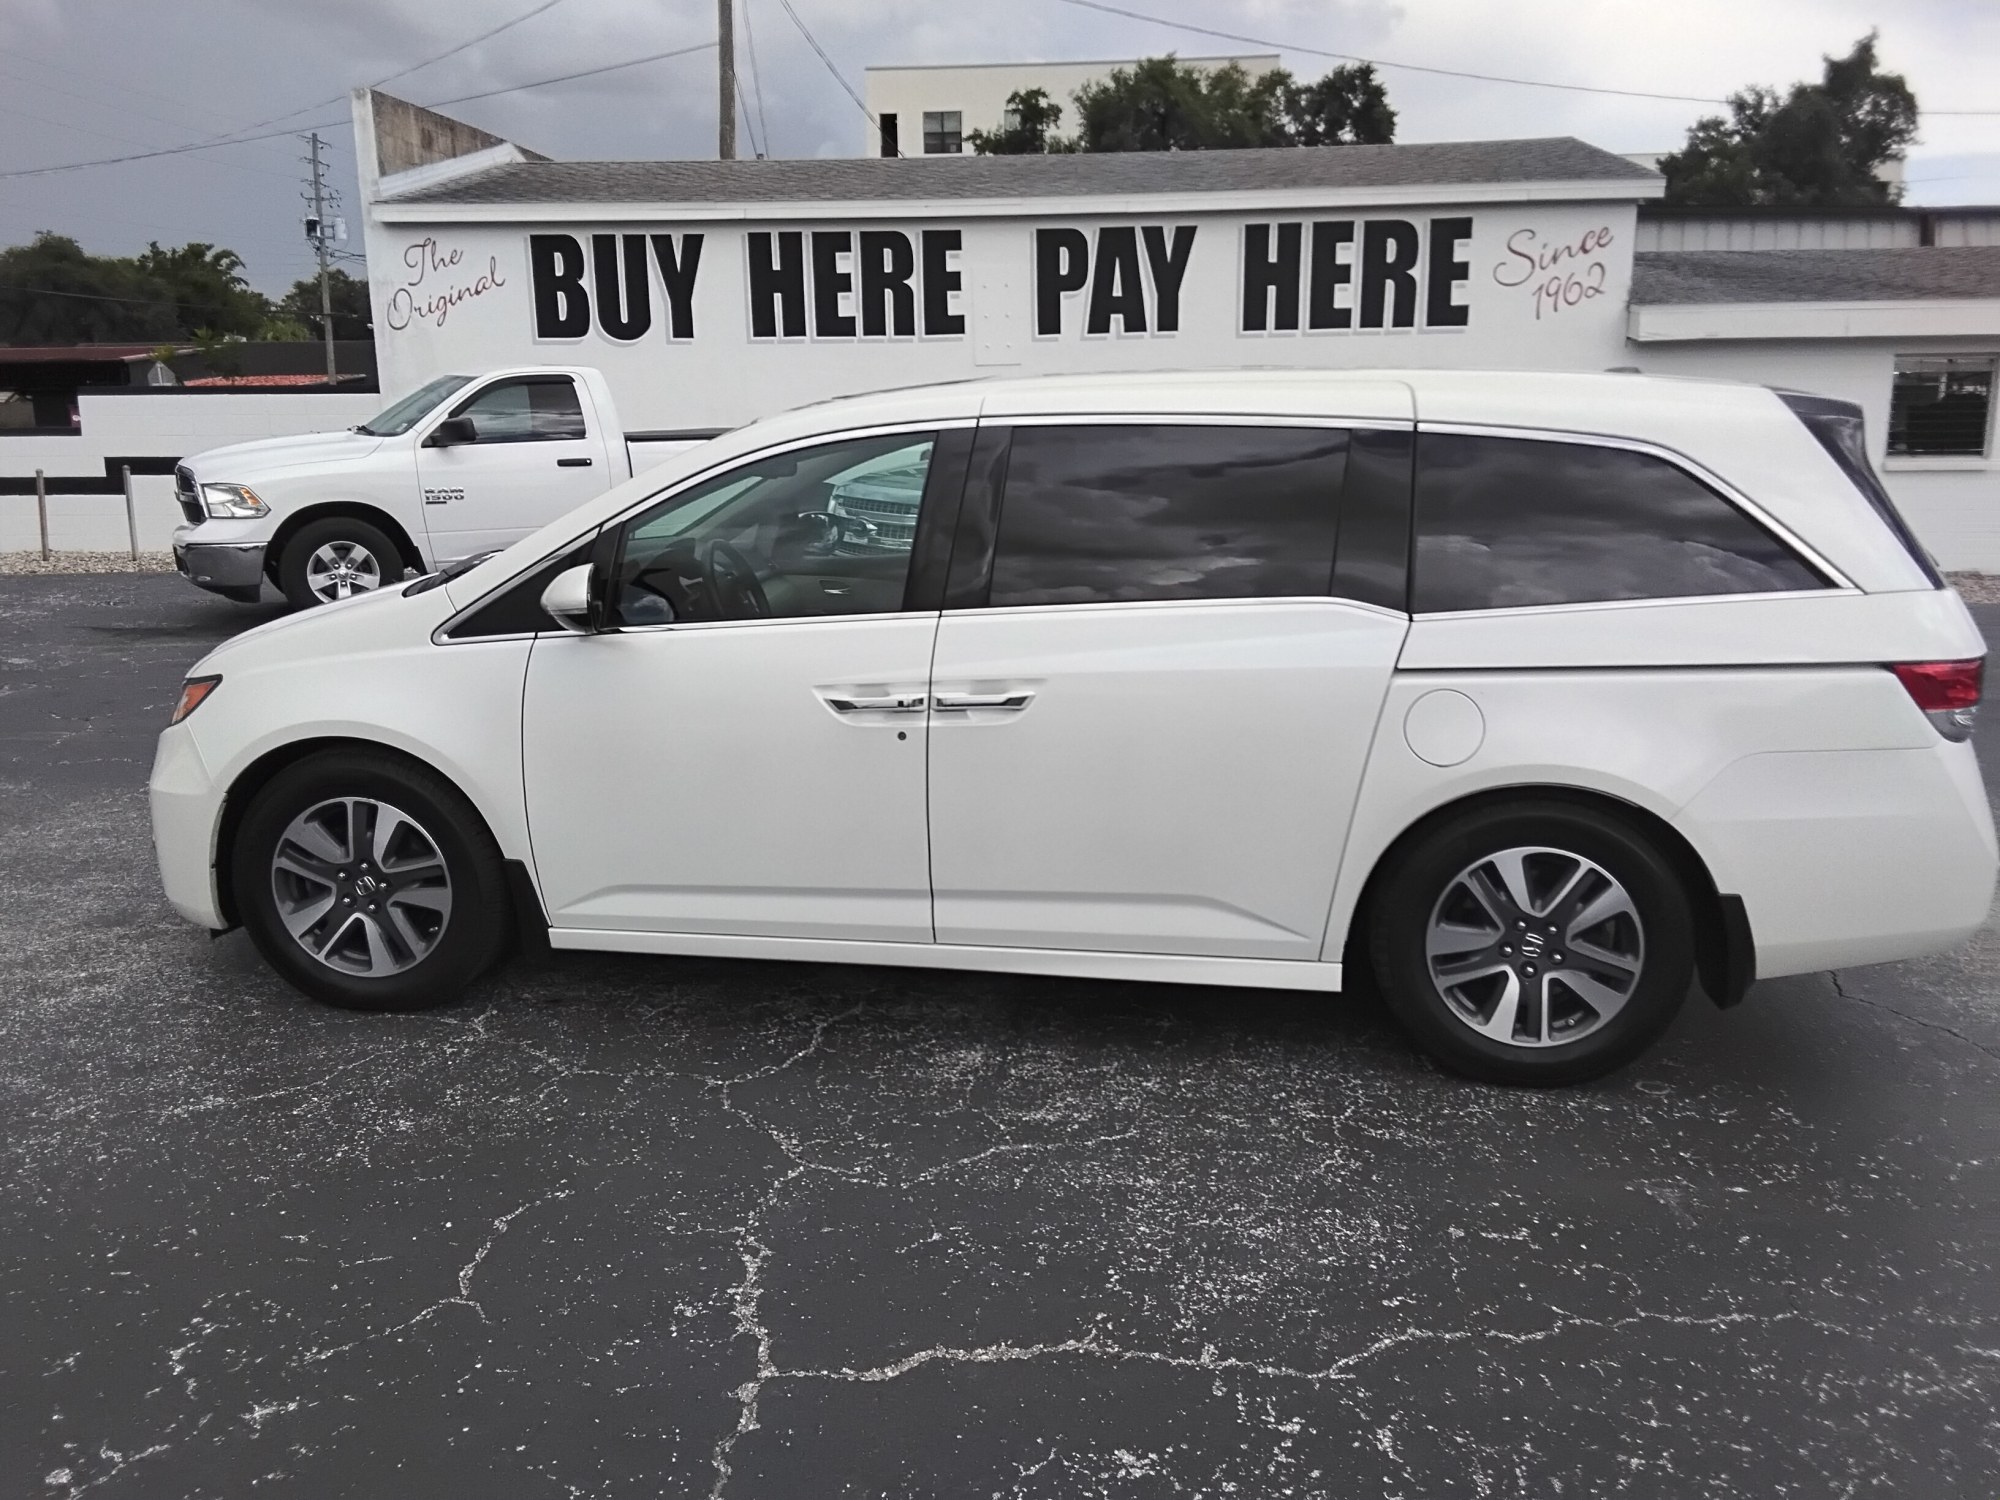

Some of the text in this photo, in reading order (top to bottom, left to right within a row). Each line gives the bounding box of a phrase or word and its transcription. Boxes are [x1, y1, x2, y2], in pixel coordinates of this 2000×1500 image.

[403, 237, 464, 287] The
[528, 217, 1473, 341] BUY HERE PAY HERE
[1492, 226, 1614, 287] Since
[386, 254, 506, 331] Original
[1531, 261, 1606, 321] 1962
